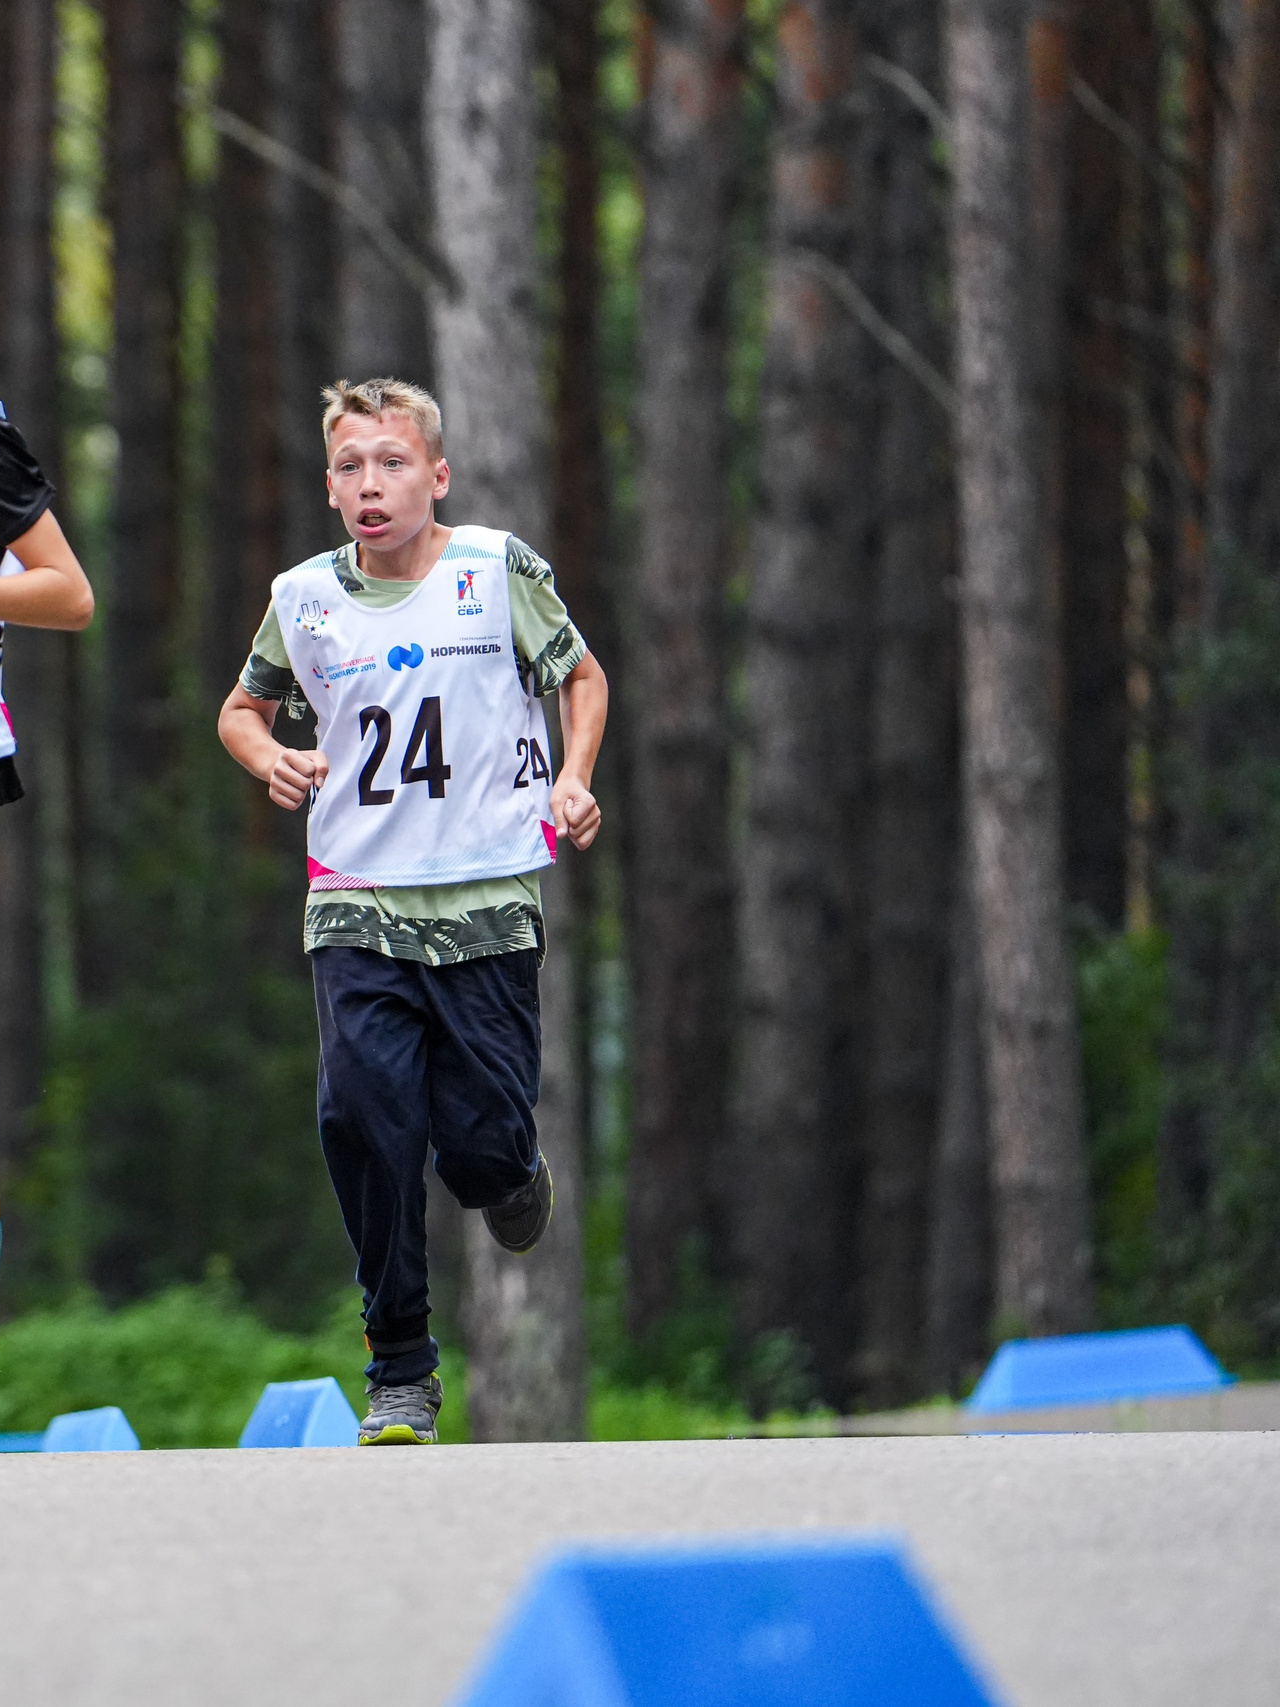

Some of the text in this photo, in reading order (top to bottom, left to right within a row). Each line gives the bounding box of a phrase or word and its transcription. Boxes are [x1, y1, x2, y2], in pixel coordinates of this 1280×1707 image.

[457, 608, 484, 617] СБР
[430, 643, 502, 658] НОРНИКЕЛЬ
[360, 662, 377, 672] 2019
[357, 695, 452, 807] 24
[513, 737, 551, 789] 24
